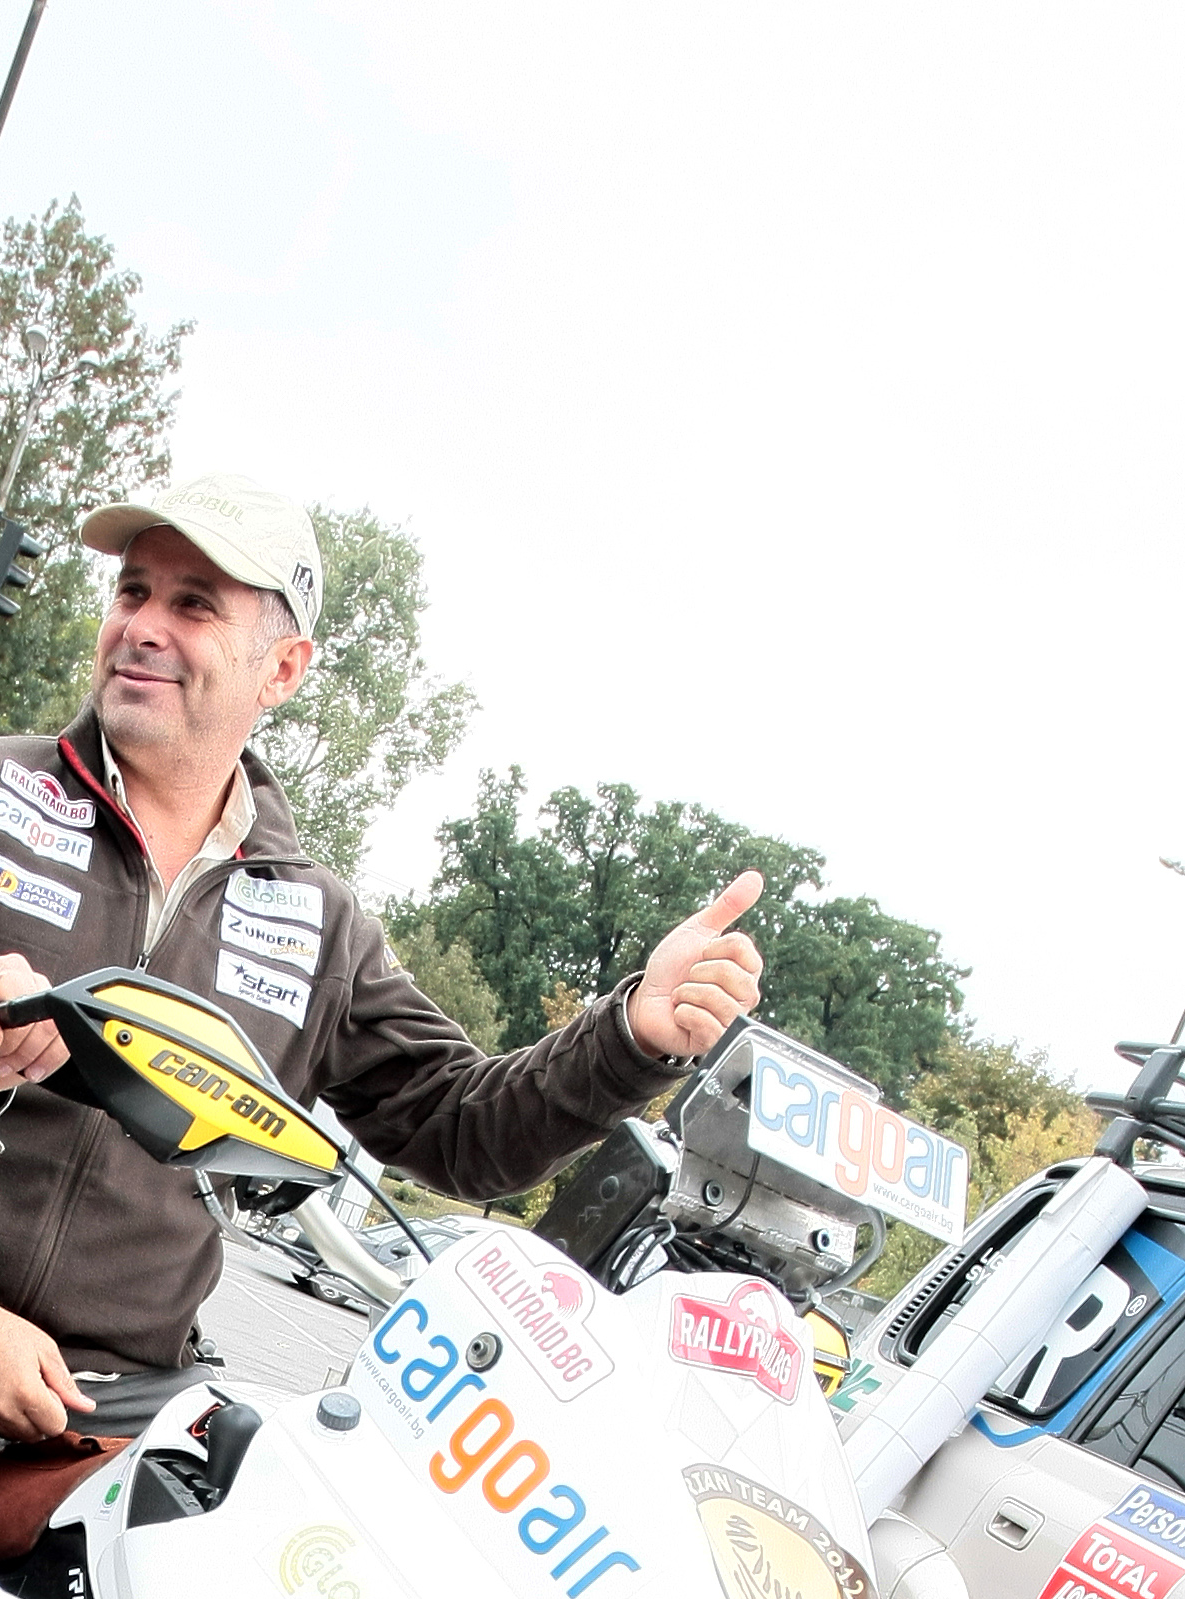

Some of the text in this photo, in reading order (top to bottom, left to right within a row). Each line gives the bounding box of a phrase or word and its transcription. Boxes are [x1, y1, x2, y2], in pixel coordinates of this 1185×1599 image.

[10, 768, 88, 821] RALLYRAID.BG
[23, 891, 67, 917] SPORT
[240, 884, 313, 911] GLOBUL
[241, 973, 300, 1008] start
[148, 1049, 288, 1138] can-am
[754, 1056, 964, 1209] cargoair
[471, 1246, 593, 1383] RALLYRAID.BG
[680, 1313, 794, 1388] RALLYRAID.BG
[358, 1349, 426, 1441] www.cargoair.bg
[735, 1478, 810, 1532] TEAM
